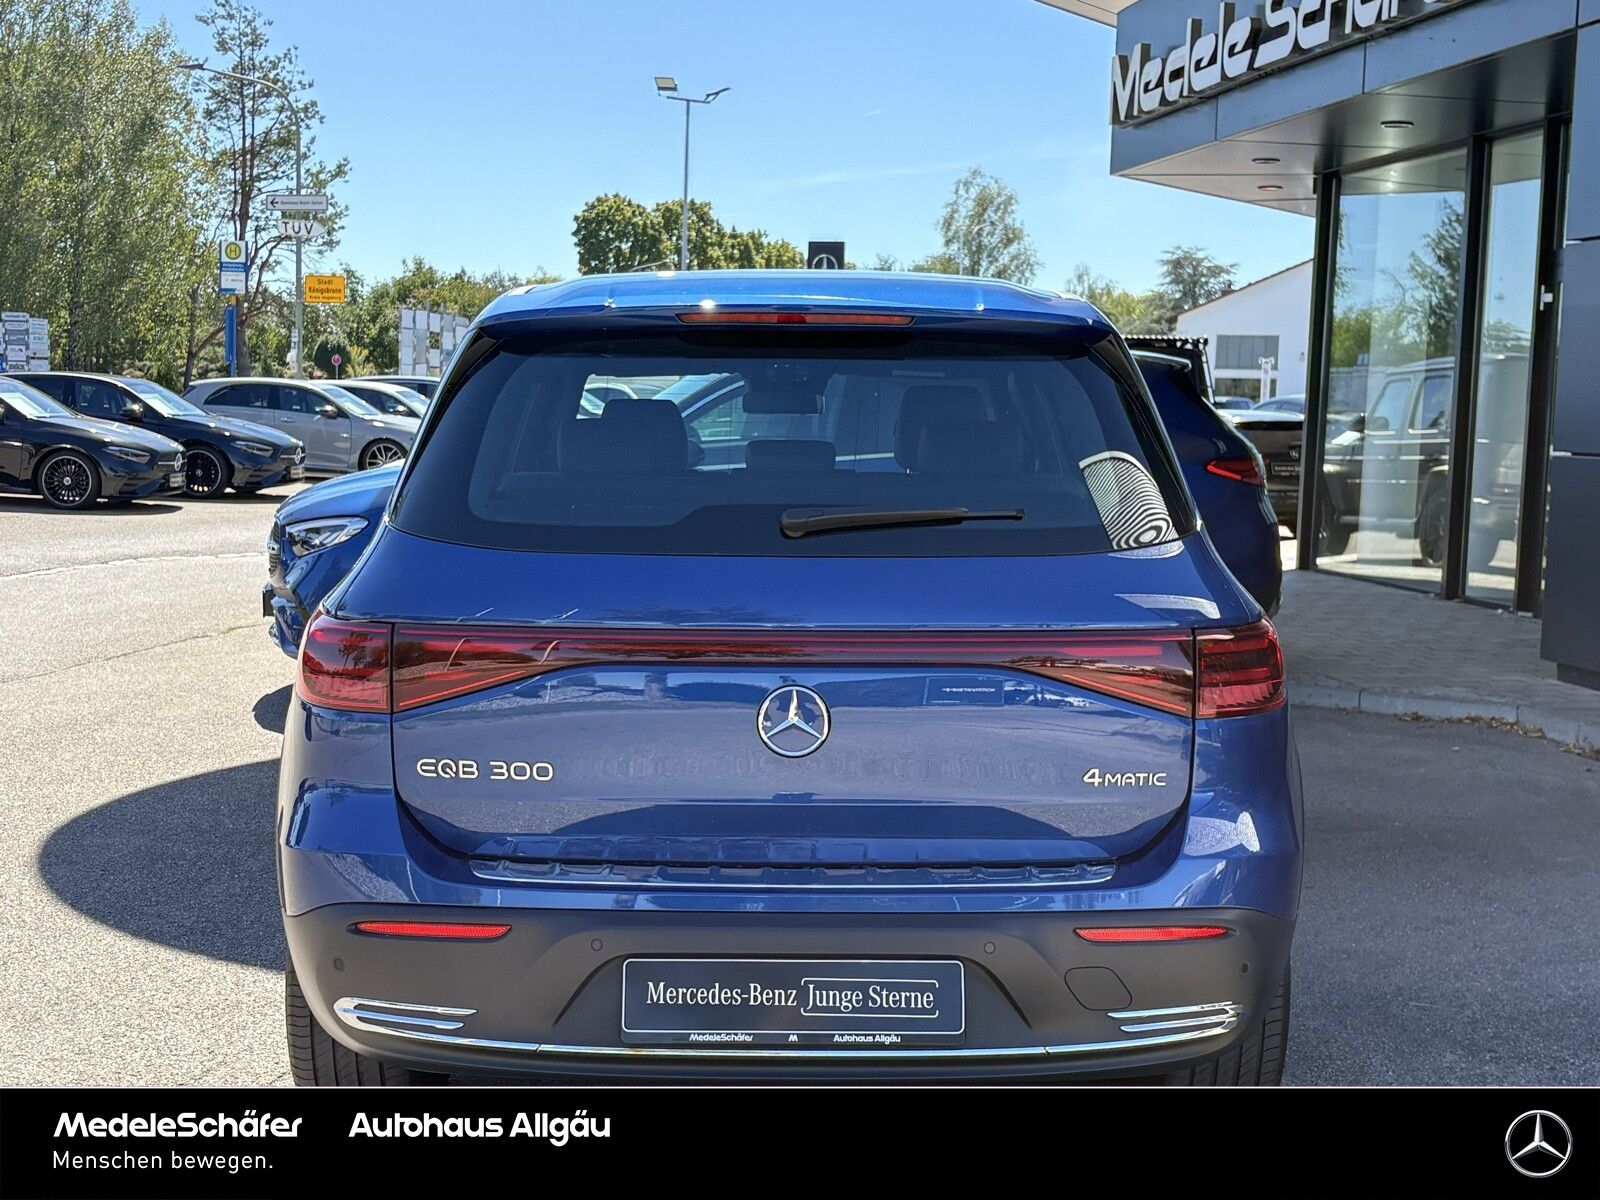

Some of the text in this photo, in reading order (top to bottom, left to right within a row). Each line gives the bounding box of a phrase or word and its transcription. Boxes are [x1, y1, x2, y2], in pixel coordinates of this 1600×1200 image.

[416, 758, 554, 781] EQB 300
[1082, 767, 1168, 787] 4MATIC
[646, 980, 935, 1013] Mercedes-Benz Junge Sterne
[832, 1033, 874, 1043] Autohaus
[874, 1033, 901, 1046] Allgäu
